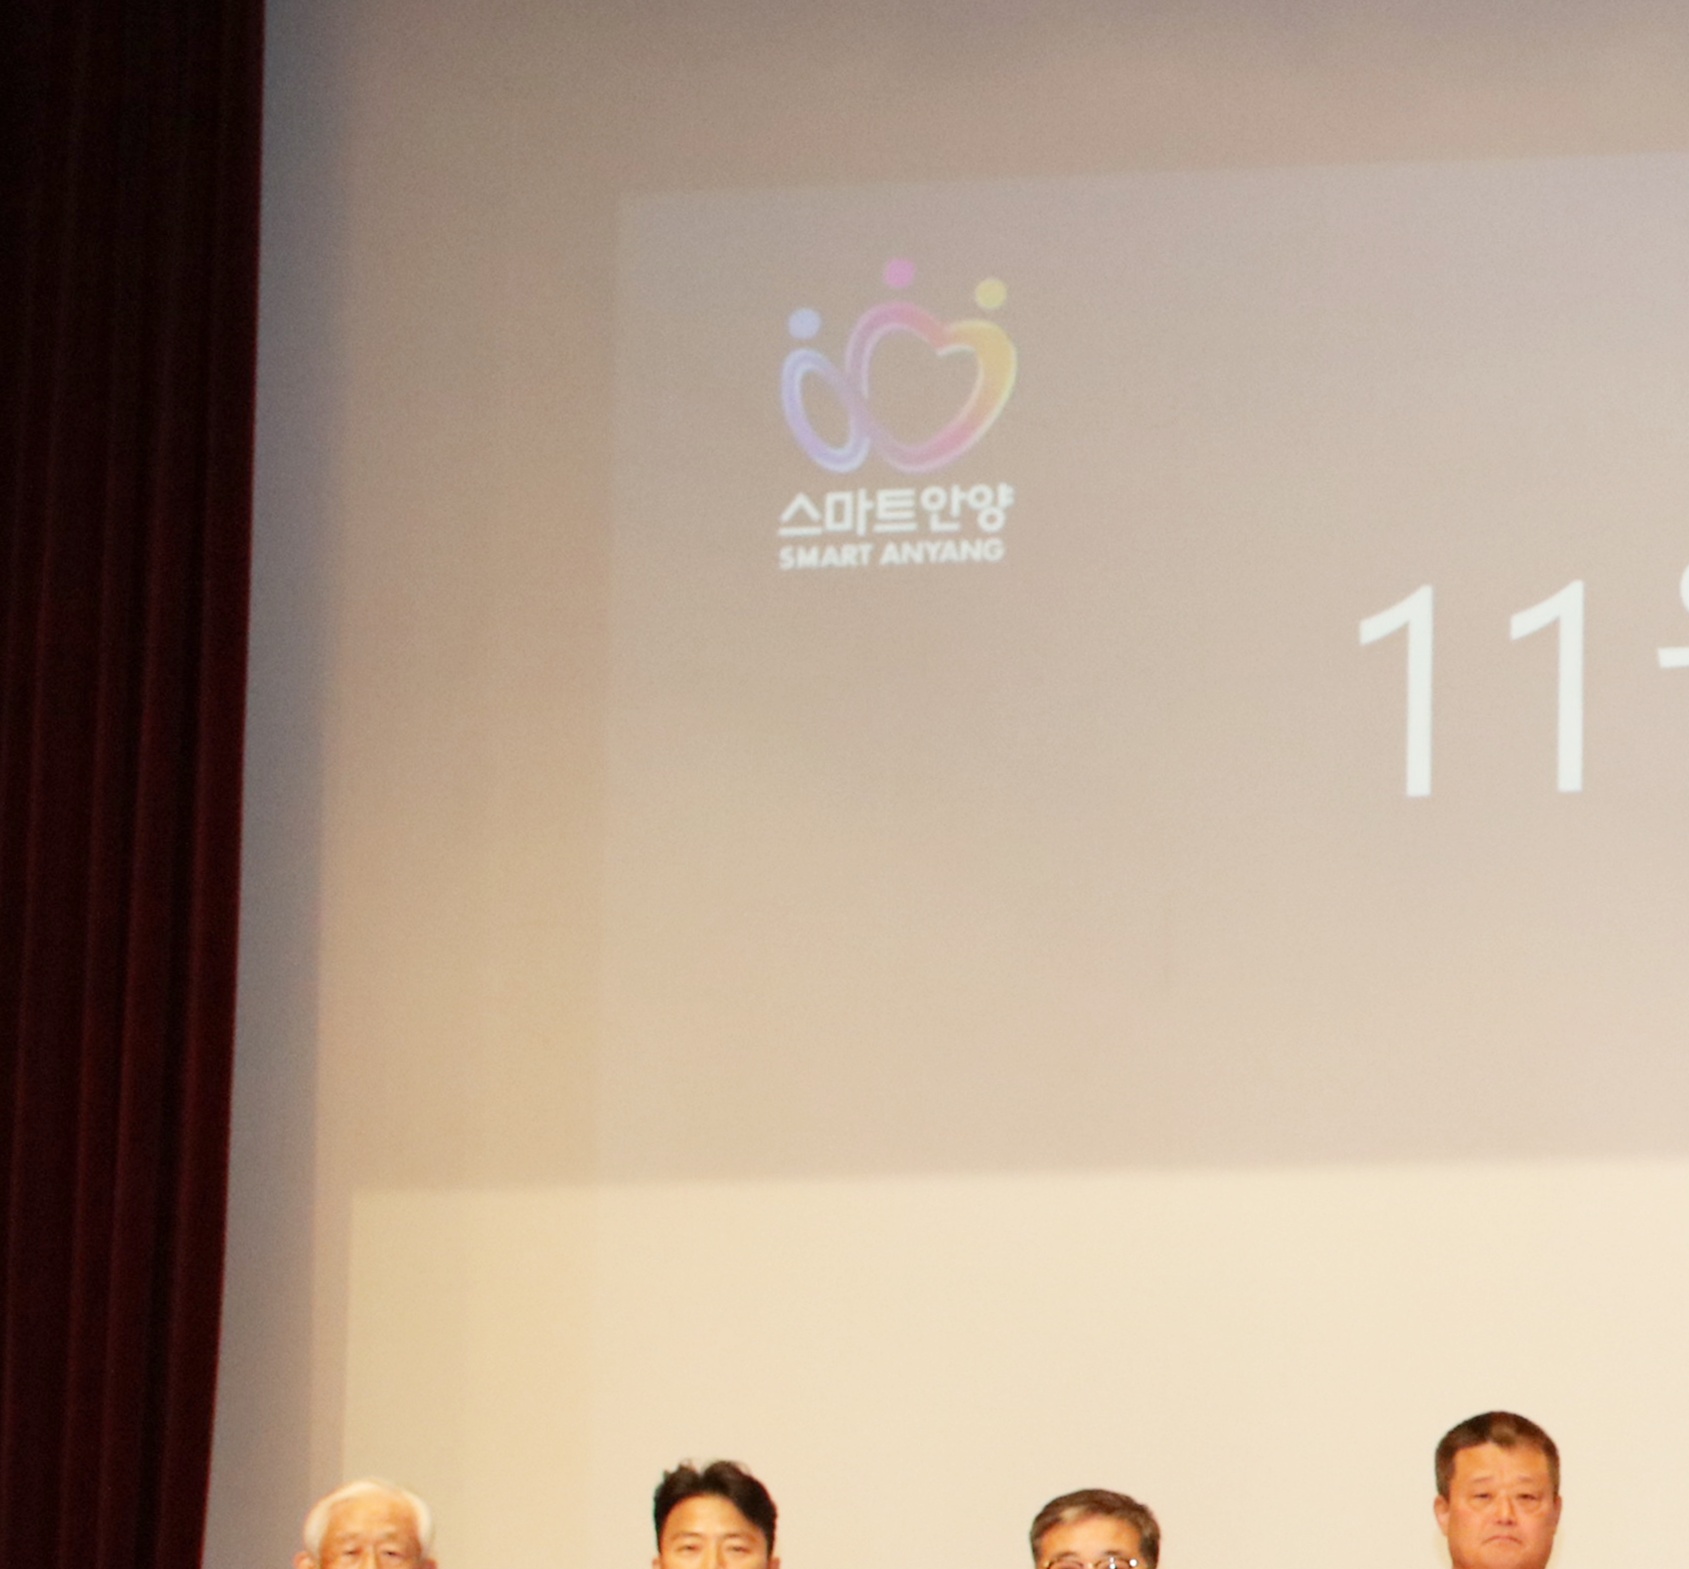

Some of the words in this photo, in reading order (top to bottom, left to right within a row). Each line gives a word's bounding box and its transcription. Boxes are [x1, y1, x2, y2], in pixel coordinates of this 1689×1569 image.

[778, 482, 1015, 536] 스마트안양
[779, 543, 872, 569] SMART
[880, 537, 1005, 564] ANYANG
